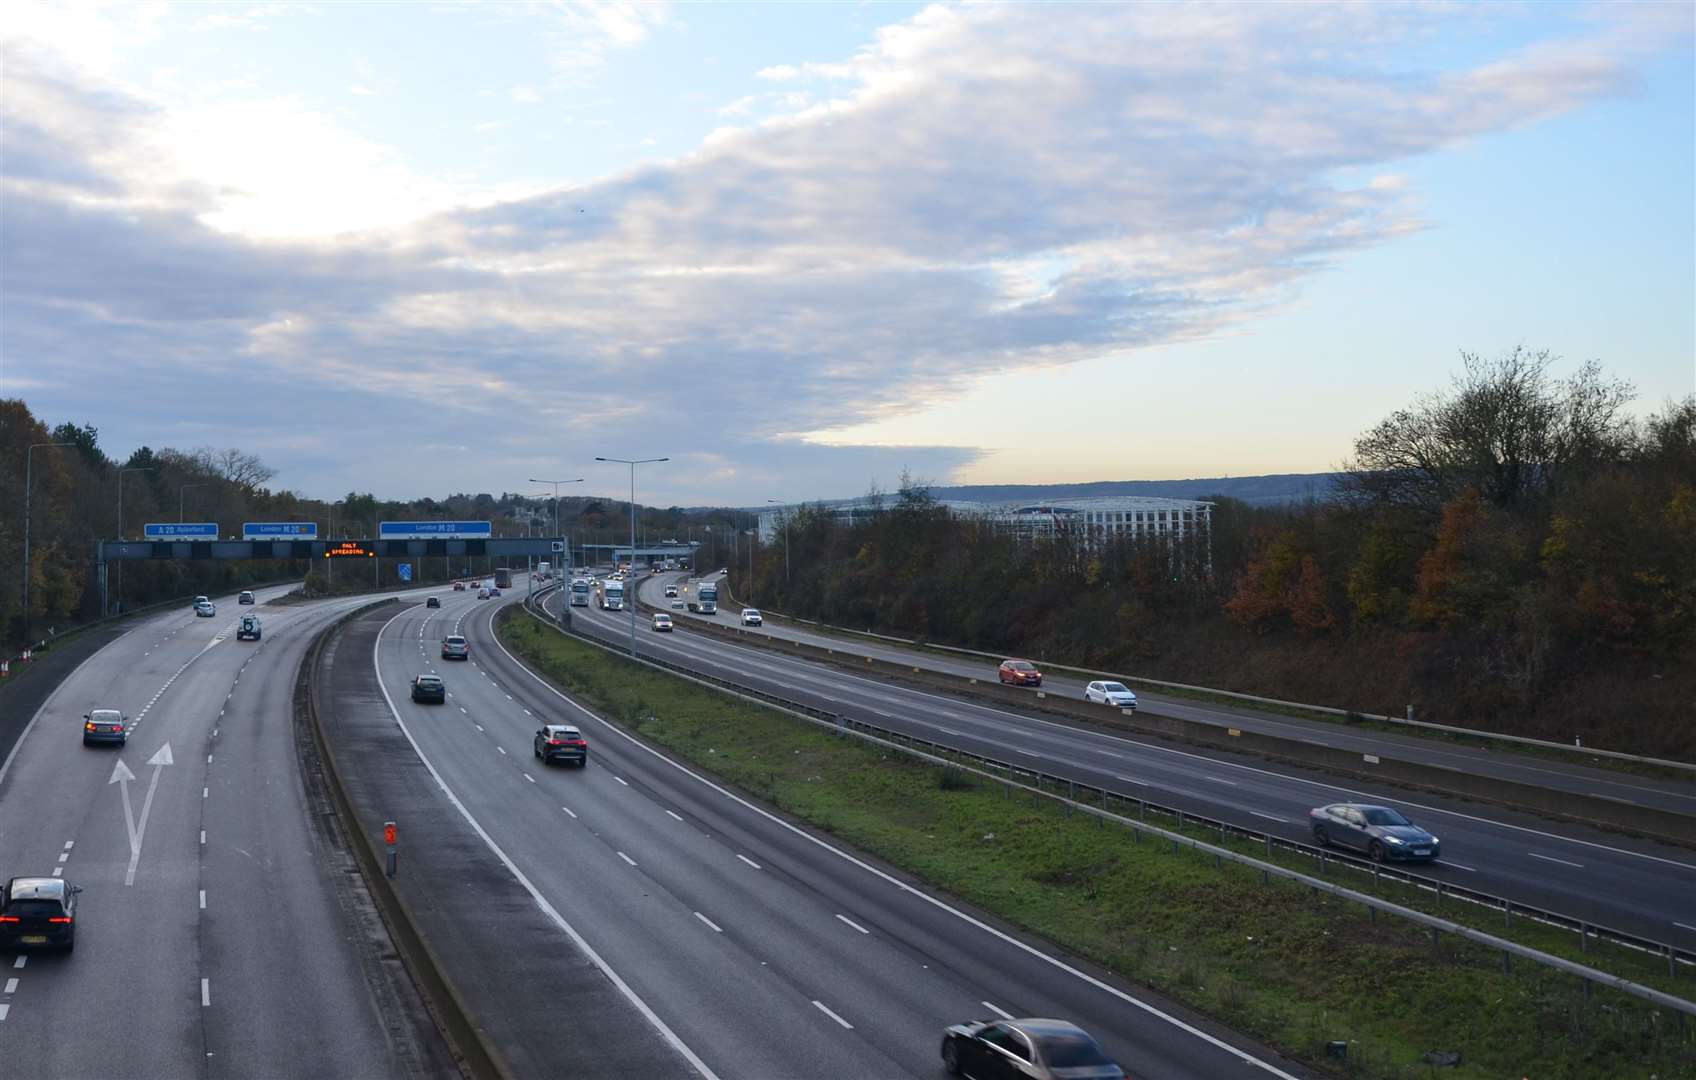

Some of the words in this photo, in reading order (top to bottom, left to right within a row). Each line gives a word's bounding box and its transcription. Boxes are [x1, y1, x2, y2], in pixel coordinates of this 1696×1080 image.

[158, 526, 164, 534] A
[165, 526, 175, 534] 20
[283, 525, 290, 533] M
[290, 525, 300, 533] 20
[438, 524, 445, 532] M
[446, 524, 455, 532] 20
